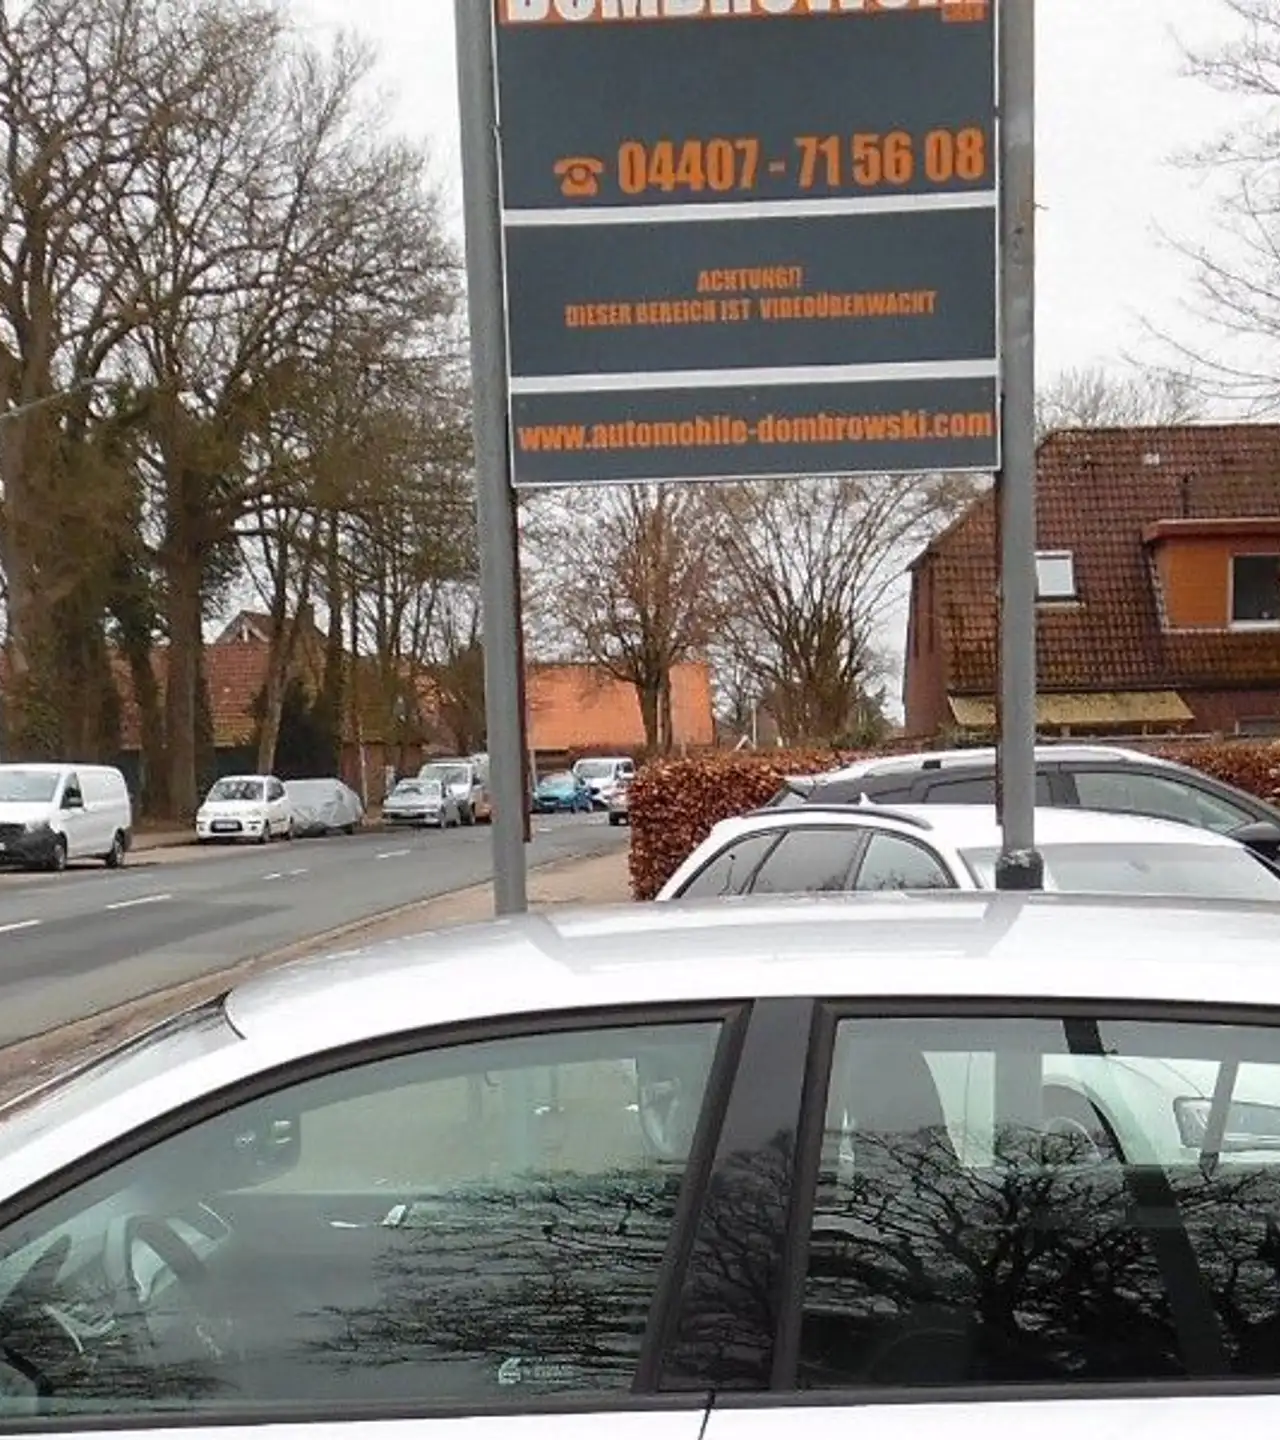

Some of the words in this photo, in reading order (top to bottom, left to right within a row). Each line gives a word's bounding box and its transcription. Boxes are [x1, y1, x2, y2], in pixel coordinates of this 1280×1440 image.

[618, 138, 759, 194] 04407
[794, 133, 841, 189] 71
[852, 129, 914, 187] 56
[924, 126, 985, 183] 08
[564, 302, 632, 328] DIESER
[634, 298, 716, 325] BEREICH
[719, 297, 754, 321] IST
[759, 289, 938, 321] VIDEOÜBERWACHT
[517, 410, 992, 451] www.automobile-dombrowski.com
